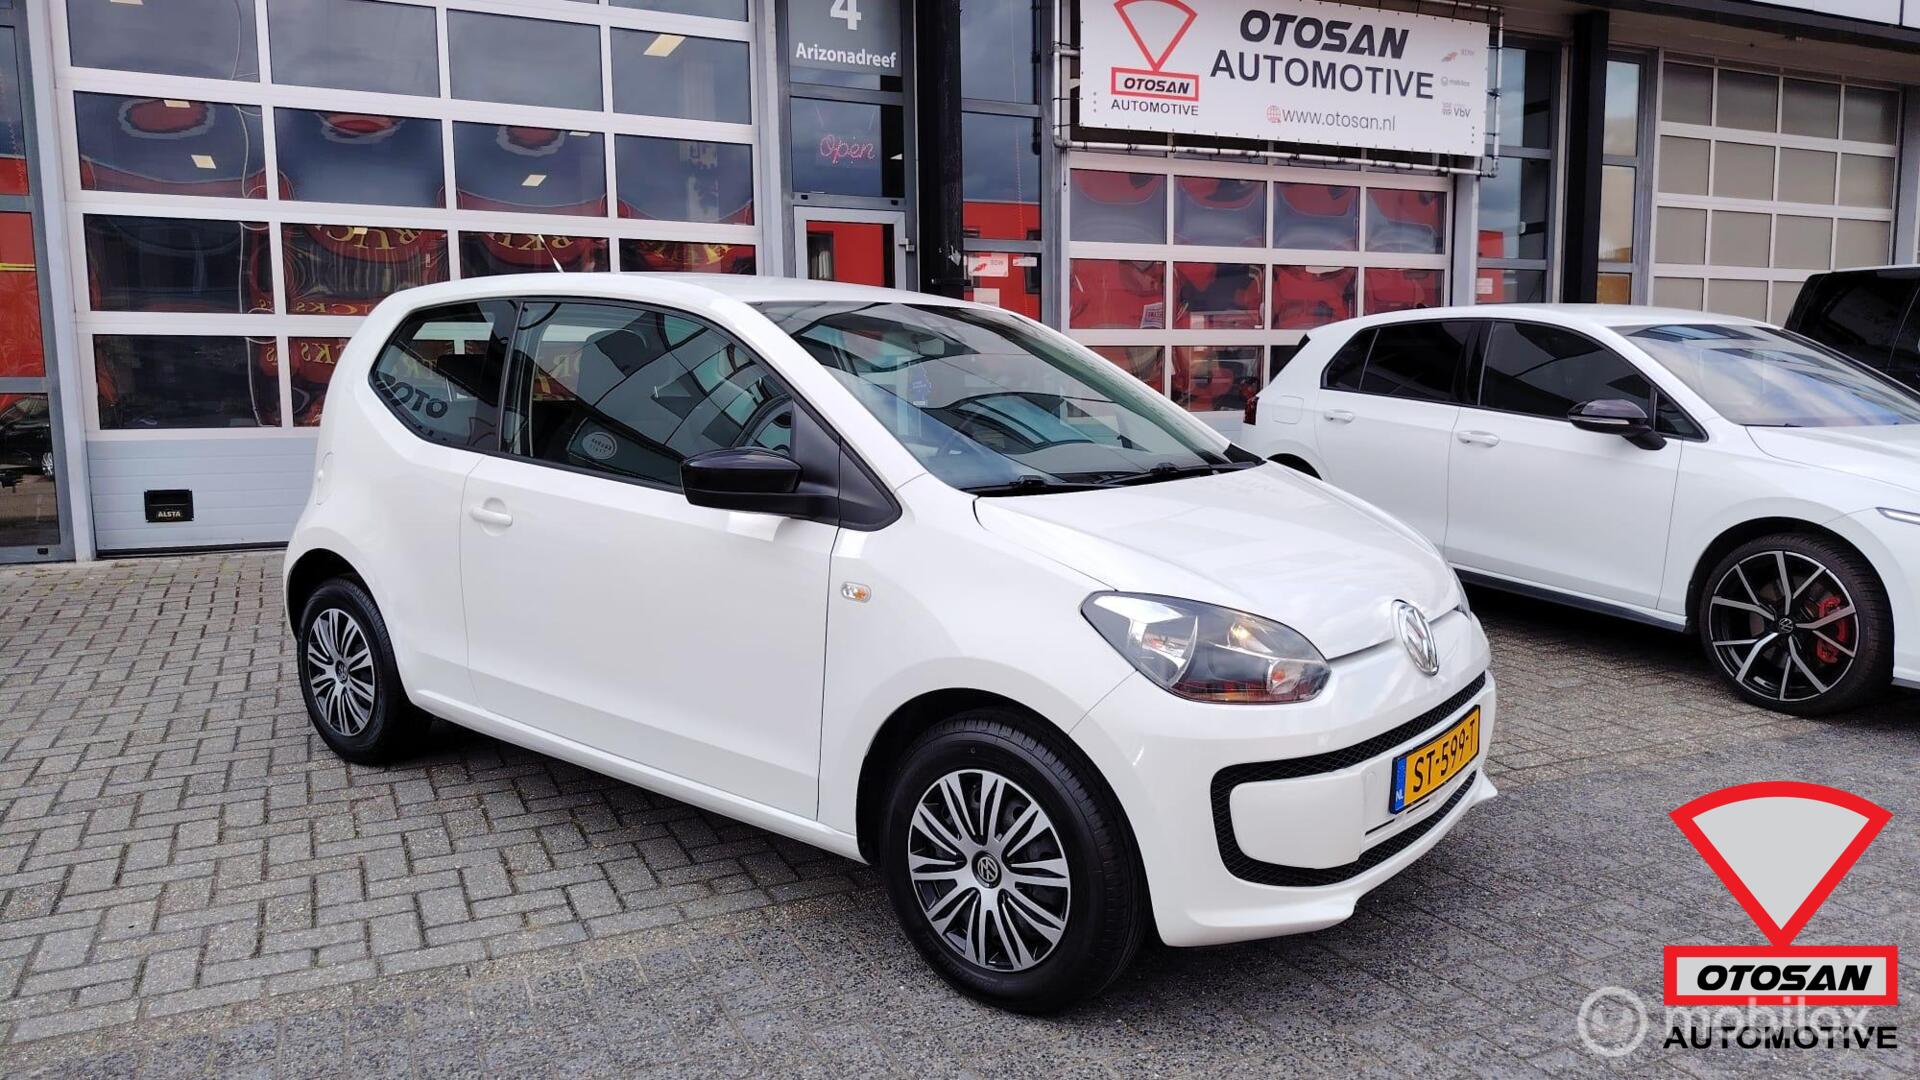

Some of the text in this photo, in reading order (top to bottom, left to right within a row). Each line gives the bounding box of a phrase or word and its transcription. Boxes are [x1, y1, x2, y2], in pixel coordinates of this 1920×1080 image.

[831, 0, 861, 30] 4
[1240, 10, 1410, 59] OTOSAN
[795, 42, 897, 68] Arizonadreef
[1123, 77, 1190, 95] OTOSAN
[1210, 50, 1434, 99] AUTOMOTIVE
[1111, 98, 1199, 116] AUTOMOTIVE
[1282, 106, 1396, 132] www.otosan.nl
[820, 134, 876, 164] Open
[1412, 719, 1476, 792] ST-599-T
